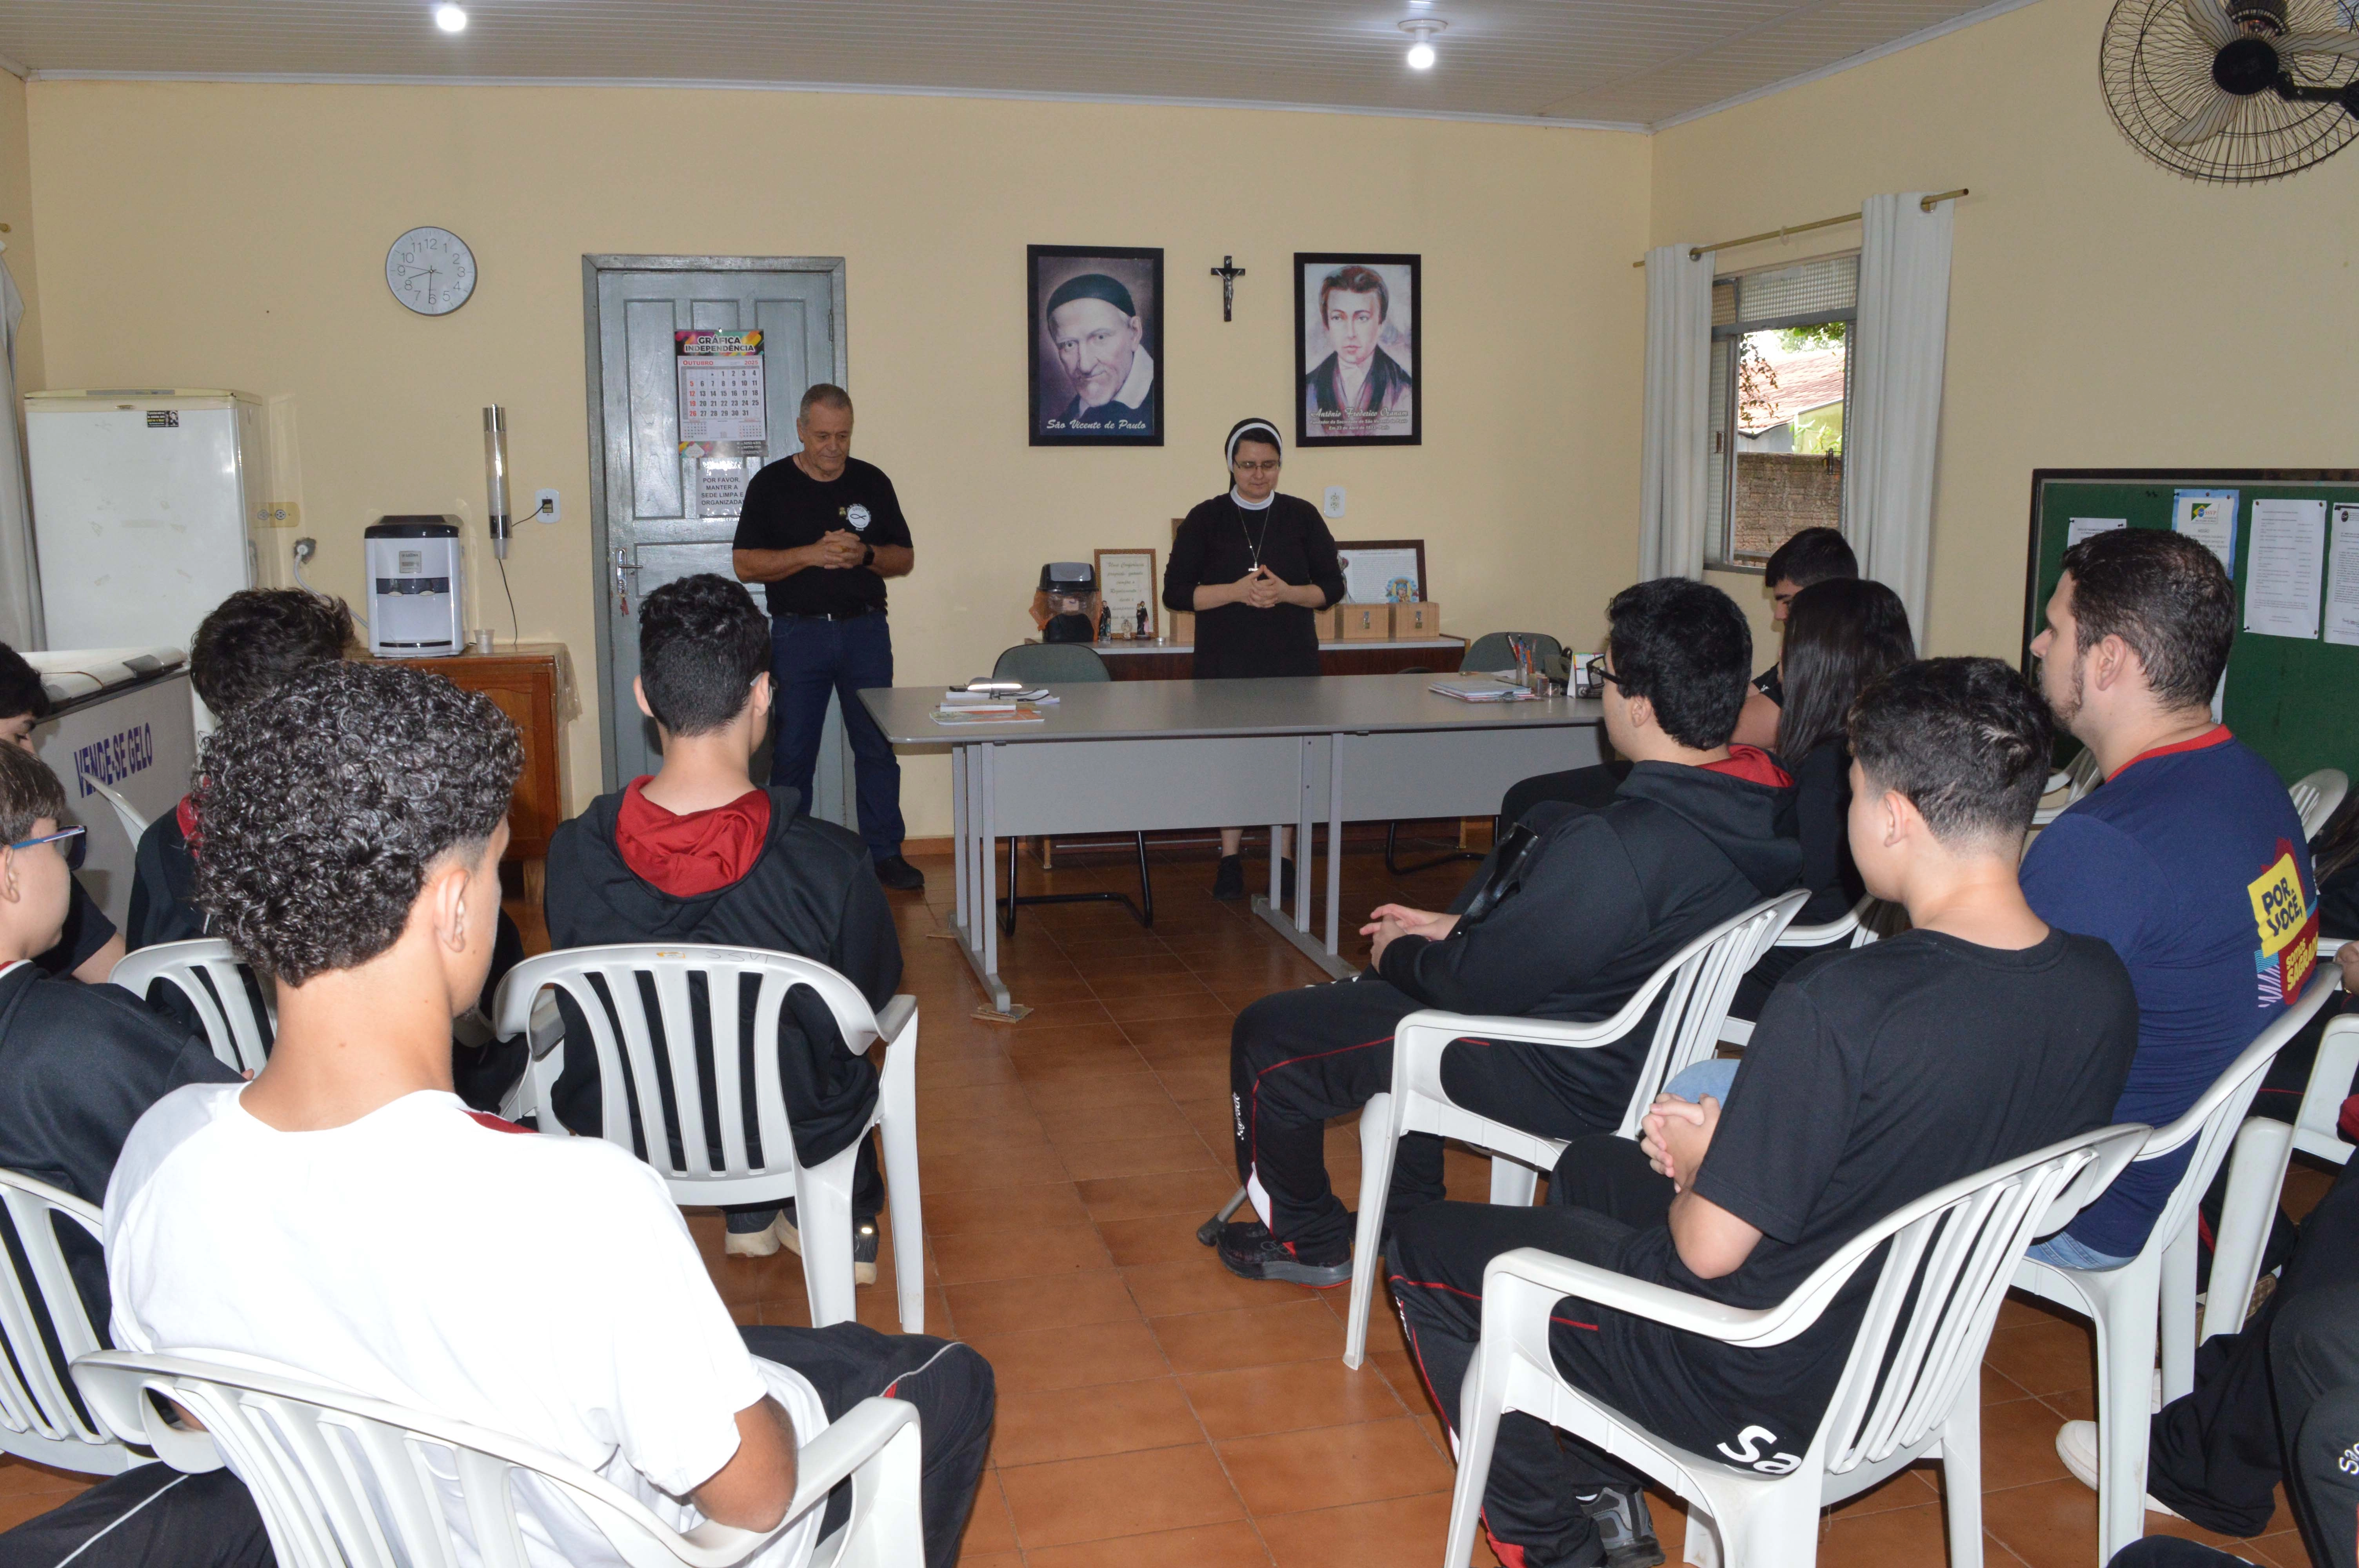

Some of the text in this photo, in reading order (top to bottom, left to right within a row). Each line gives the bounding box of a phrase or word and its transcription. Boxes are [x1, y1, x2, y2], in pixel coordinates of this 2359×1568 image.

[411, 243, 421, 253] 11
[424, 238, 437, 250] 12
[443, 243, 447, 253] 1
[402, 252, 414, 263] 10
[453, 253, 460, 264] 2
[398, 265, 405, 276] 9
[457, 267, 465, 277] 3
[404, 279, 413, 290] 8
[453, 281, 461, 291] 4
[414, 290, 421, 301] 7
[429, 294, 436, 305] 6
[442, 291, 451, 301] 5
[698, 335, 741, 344] GRÁFICA
[1310, 408, 1408, 418] Antônio Frederico Ozanam
[1047, 419, 1146, 429] São Vicente de Paulo
[128, 722, 152, 774] GELO
[2262, 877, 2291, 916] POR
[2266, 889, 2303, 937] VOCÊ,
